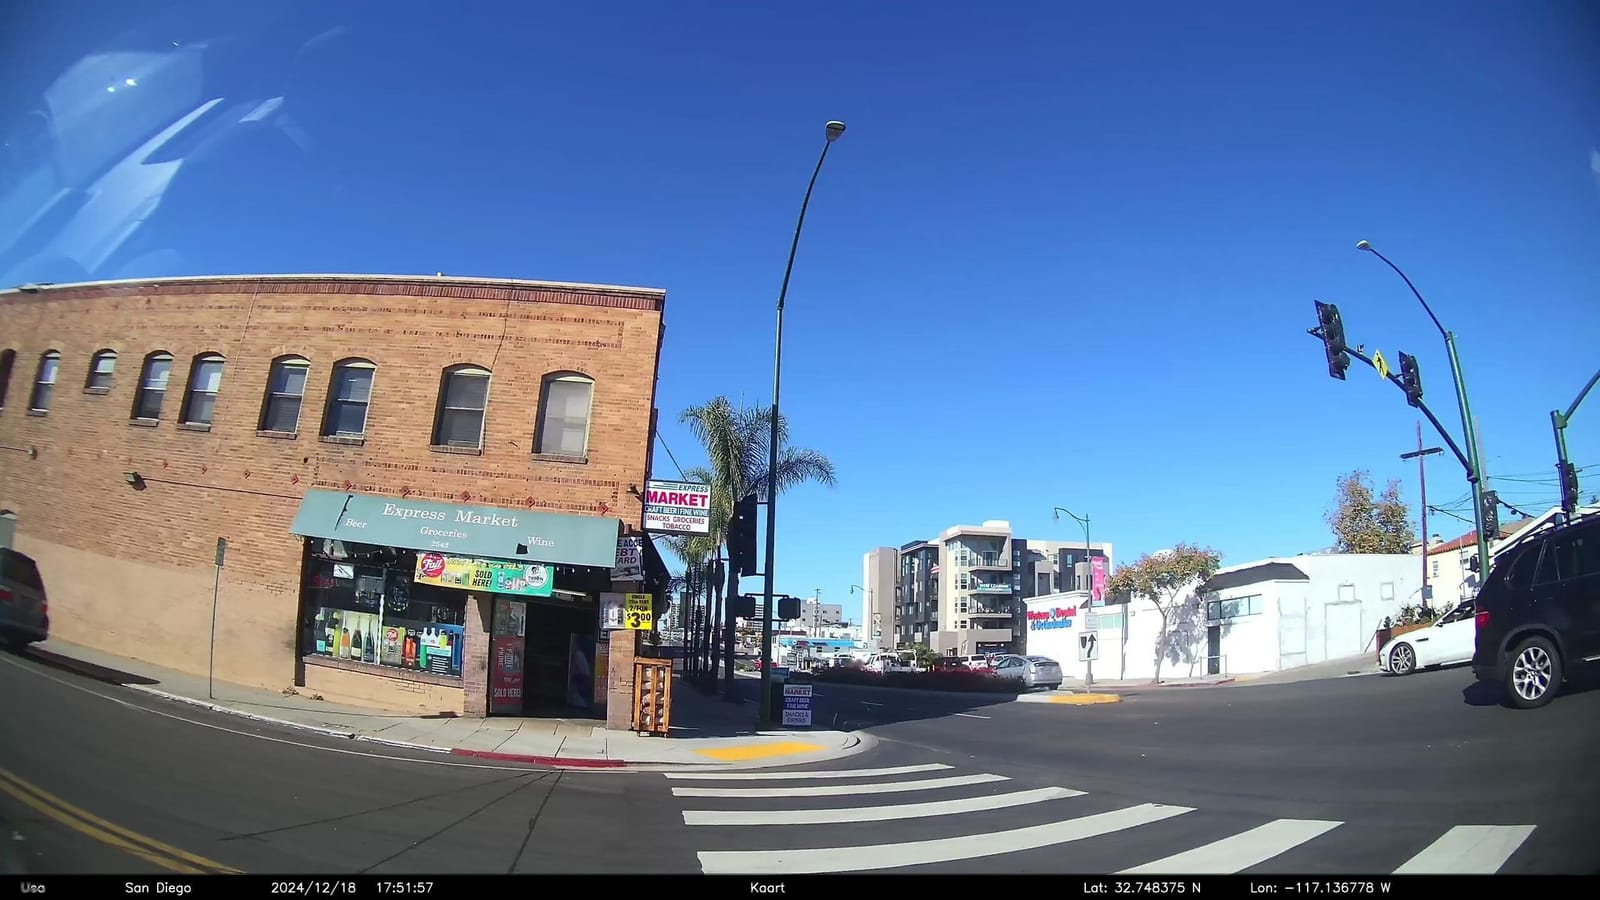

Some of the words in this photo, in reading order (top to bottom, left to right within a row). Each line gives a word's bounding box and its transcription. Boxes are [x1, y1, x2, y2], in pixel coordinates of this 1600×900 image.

[678, 484, 709, 493] EXPRESS
[646, 490, 709, 507] MARKET
[381, 502, 447, 522] Express
[453, 508, 519, 528] Market
[663, 506, 678, 515] BEER
[680, 508, 692, 516] FINE
[693, 508, 709, 517] WINE
[344, 517, 368, 529] Beer
[647, 514, 671, 522] SNACKS
[673, 516, 705, 525] GROCERIES
[419, 525, 468, 539] Groceries
[662, 522, 692, 531] TOBACCO
[527, 535, 555, 548] Wine
[474, 569, 492, 579] SOLD
[472, 578, 492, 588] HERE!
